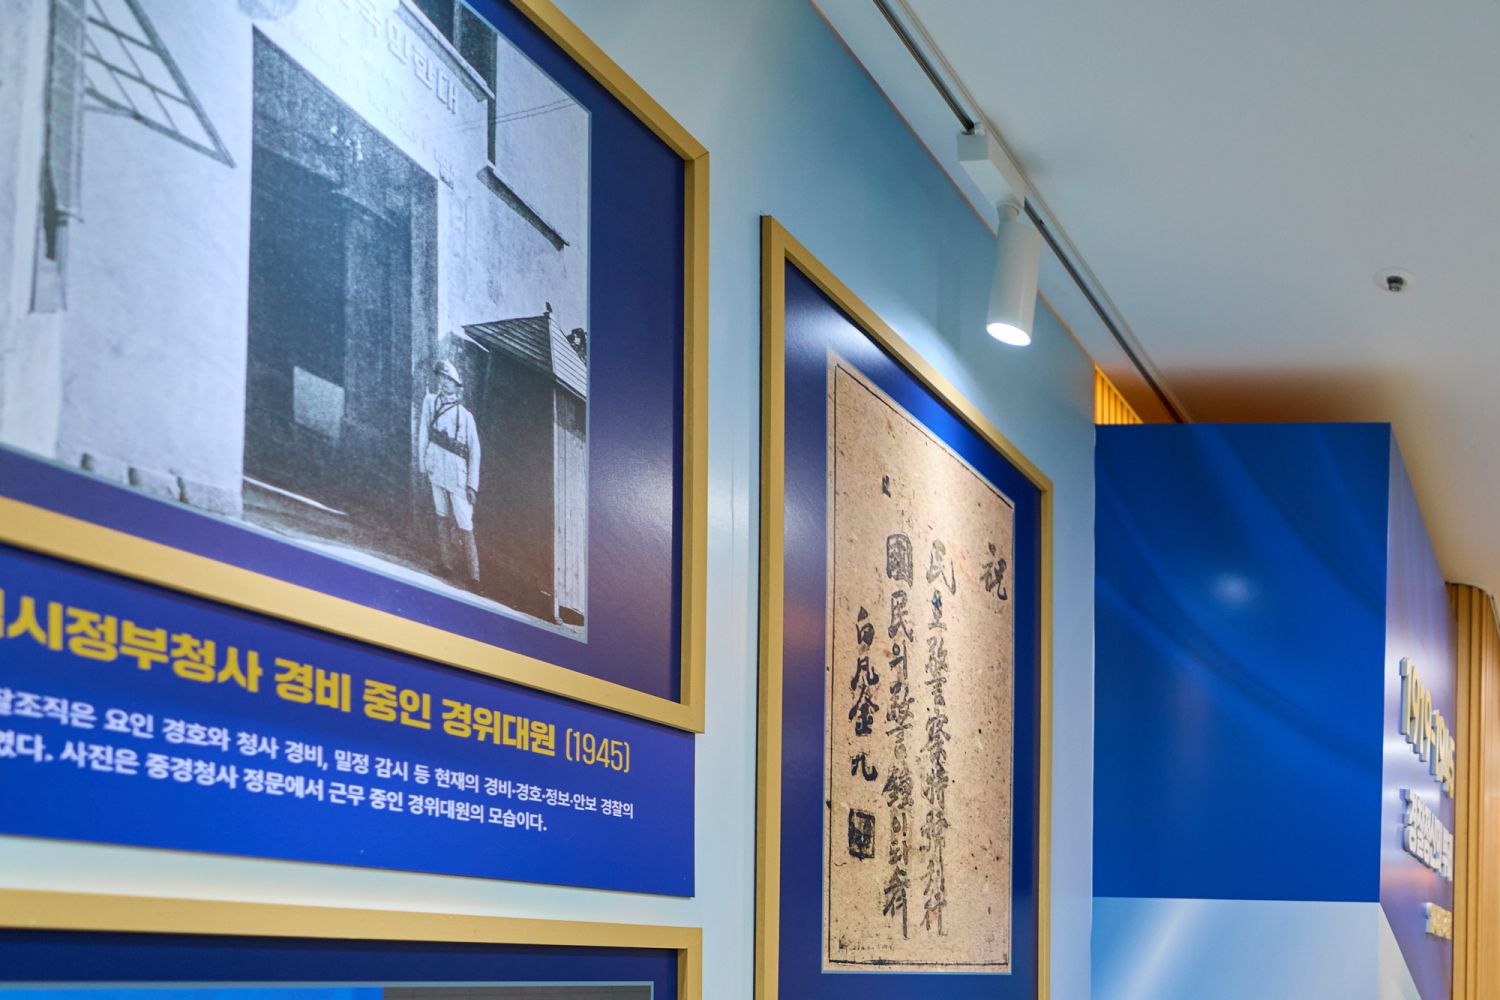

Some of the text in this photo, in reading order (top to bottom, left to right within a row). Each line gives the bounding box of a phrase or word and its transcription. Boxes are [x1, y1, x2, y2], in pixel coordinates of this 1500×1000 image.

[0, 587, 630, 773] 시정부청사 경비 중인 경위대원 (1945)
[60, 740, 140, 775] 사진은
[145, 752, 239, 790] 중경청사
[243, 768, 324, 801] 정문에서
[329, 783, 365, 806] 근무
[369, 789, 403, 812] 중인
[408, 794, 484, 823] 경위대원의
[488, 809, 547, 831] 모습이다.
[104, 709, 154, 739] 요인
[163, 718, 230, 751] 경호와
[236, 731, 278, 759] 청사
[285, 740, 328, 771] 경비,
[334, 750, 369, 775] 밀정
[375, 757, 409, 781] 감시
[413, 763, 430, 784] 등
[435, 768, 480, 793] 현재의
[600, 798, 634, 820] 경찰의
